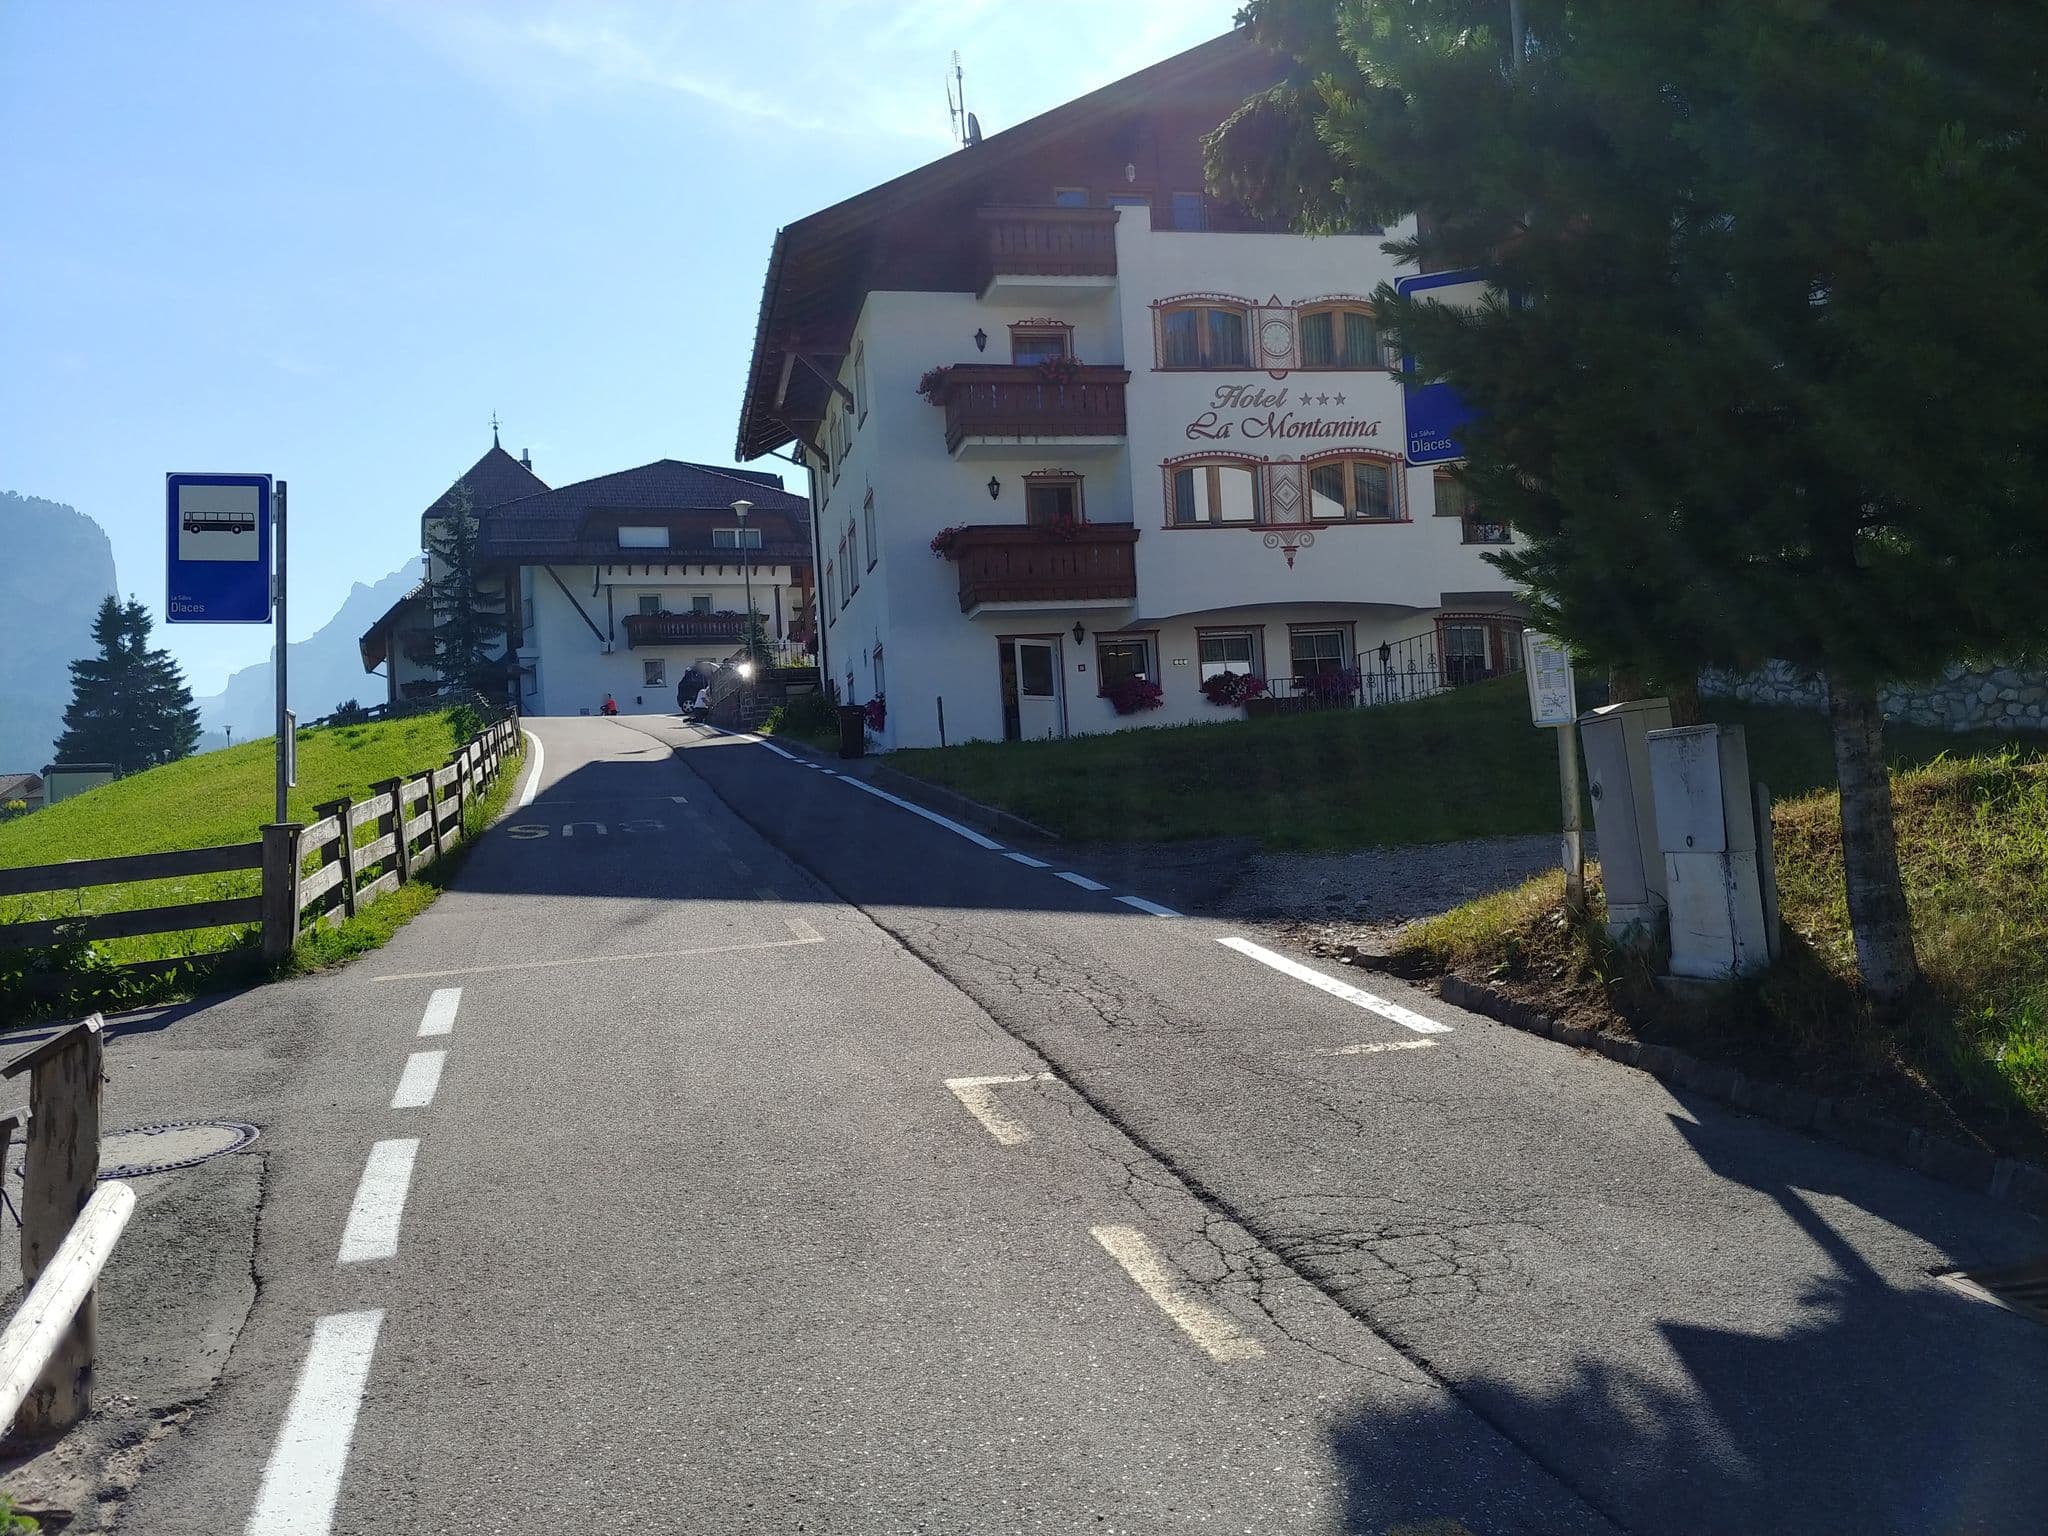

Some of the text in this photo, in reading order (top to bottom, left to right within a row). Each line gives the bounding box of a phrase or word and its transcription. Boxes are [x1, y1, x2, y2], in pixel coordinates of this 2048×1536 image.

[1210, 384, 1288, 408] Hotel
[1186, 412, 1382, 440] La Montanina
[1411, 439, 1452, 453] Dlaces
[171, 602, 205, 612] Dlaces
